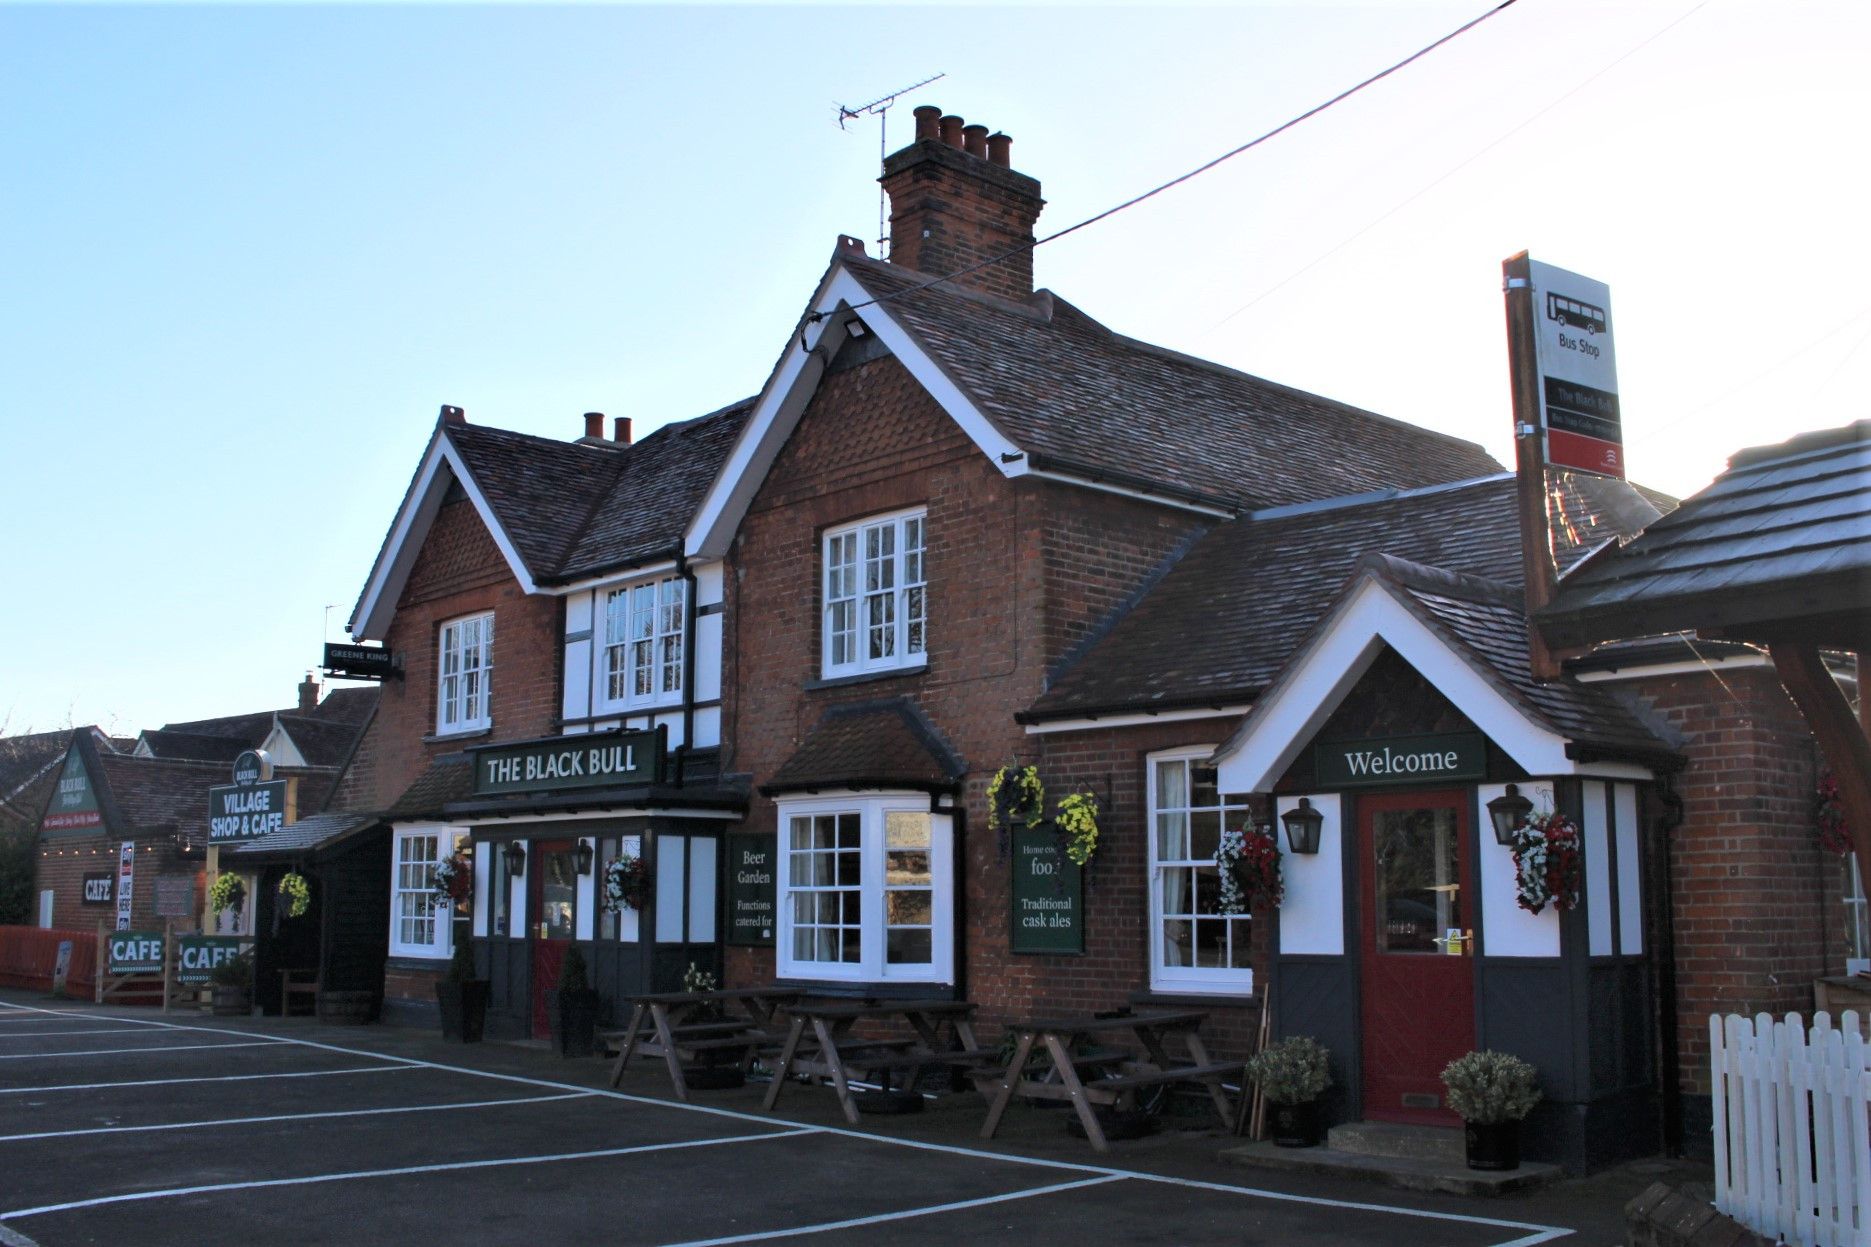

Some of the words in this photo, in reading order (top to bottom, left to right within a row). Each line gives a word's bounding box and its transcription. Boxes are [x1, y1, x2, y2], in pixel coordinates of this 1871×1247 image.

[1558, 332, 1577, 350] Bus
[1580, 338, 1600, 360] Stop
[331, 650, 364, 660] GREENE
[367, 653, 388, 662] KING
[487, 756, 522, 784] THE
[526, 750, 584, 780] BLACK
[588, 744, 637, 776] BULL
[1344, 747, 1458, 776] Welcome
[224, 790, 270, 814] VILLAGE
[211, 816, 240, 838] SHOP
[241, 816, 249, 836] &
[252, 812, 282, 834] CAFE
[743, 850, 766, 864] Beer
[1023, 846, 1044, 854] Home
[1032, 857, 1060, 875] foo
[737, 870, 770, 884] Garden
[86, 874, 112, 900] CAFÉ
[120, 882, 130, 896] LIVE
[737, 900, 771, 911] Functions
[1021, 896, 1072, 910] Traditional
[736, 915, 760, 926] catered
[762, 914, 772, 926] for
[1023, 912, 1047, 928] cask
[1049, 912, 1072, 928] ales
[112, 941, 161, 960] CAFE
